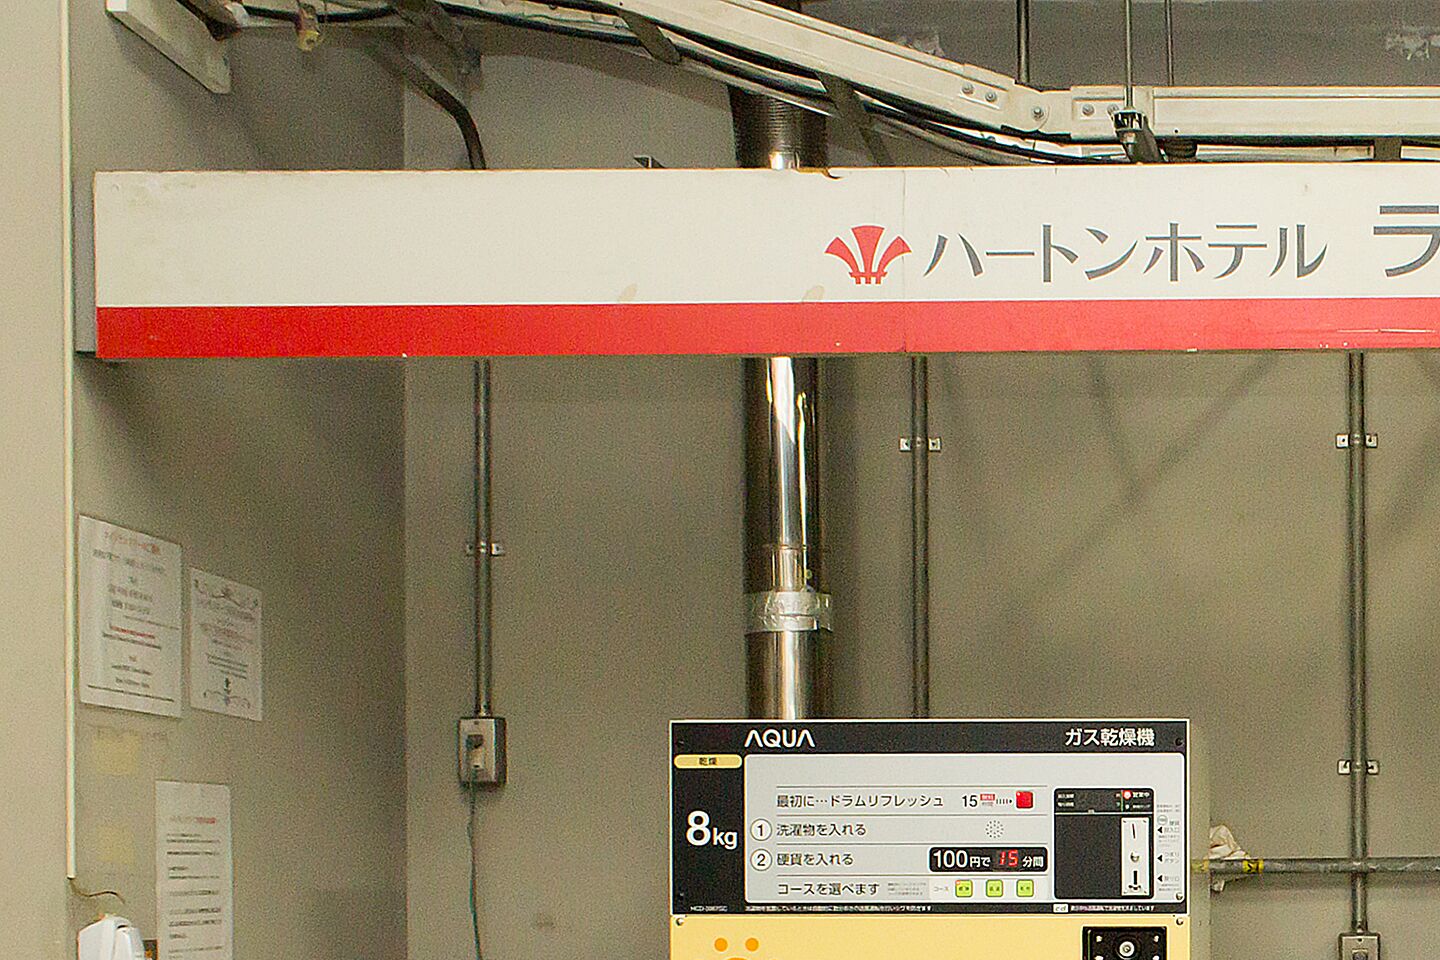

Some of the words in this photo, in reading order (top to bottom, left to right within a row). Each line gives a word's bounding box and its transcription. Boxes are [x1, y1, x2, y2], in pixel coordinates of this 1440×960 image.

[922, 222, 1329, 282] ハートンホテル
[744, 729, 815, 748] AQUA
[1065, 727, 1155, 747] ガス乾燥機
[961, 795, 978, 807] 15
[1022, 856, 1044, 868] 分間
[778, 882, 880, 895] コースを選べます
